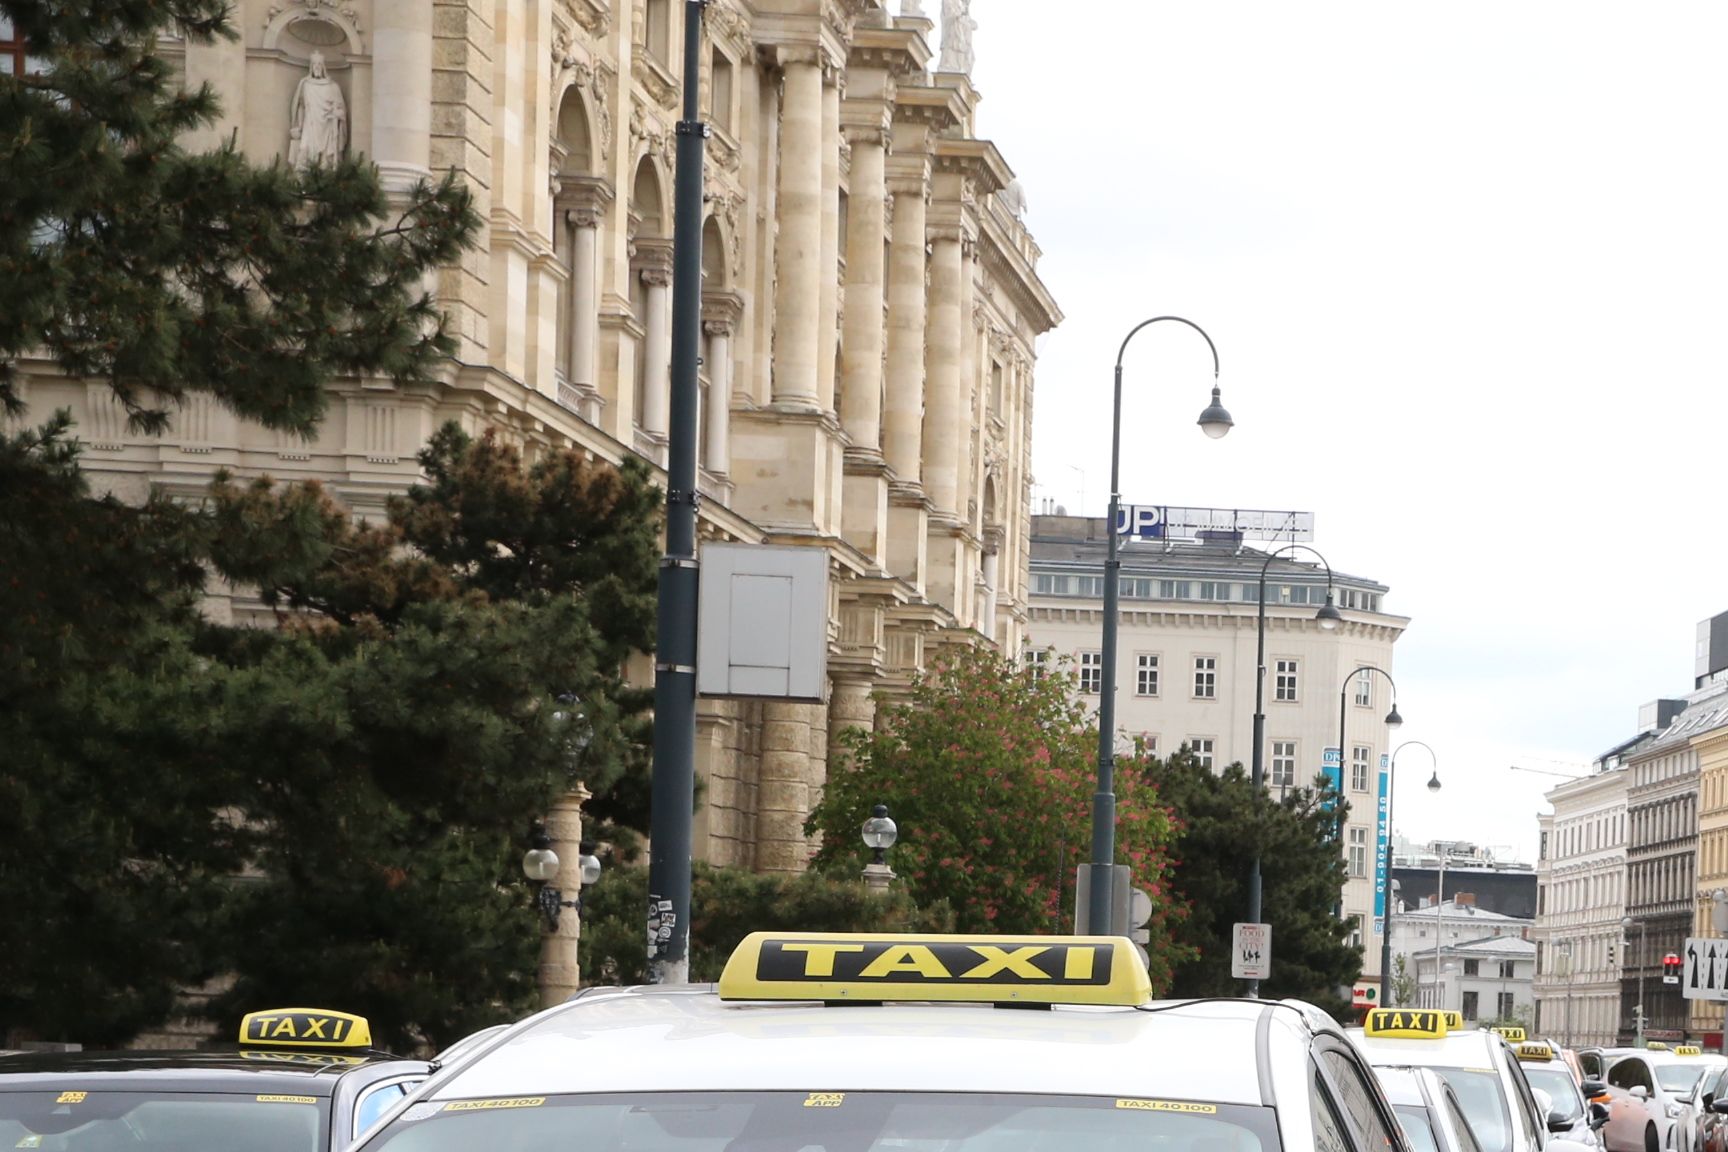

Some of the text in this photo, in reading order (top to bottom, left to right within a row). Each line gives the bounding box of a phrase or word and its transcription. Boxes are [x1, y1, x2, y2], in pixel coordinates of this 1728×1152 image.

[781, 944, 1095, 979] TAXI
[256, 1017, 344, 1040] TAXI
[1376, 1013, 1435, 1030] TAXI
[1523, 1047, 1547, 1056] TAXI
[451, 1099, 541, 1110] TAXI 40100
[1119, 1100, 1156, 1108] TAXI
